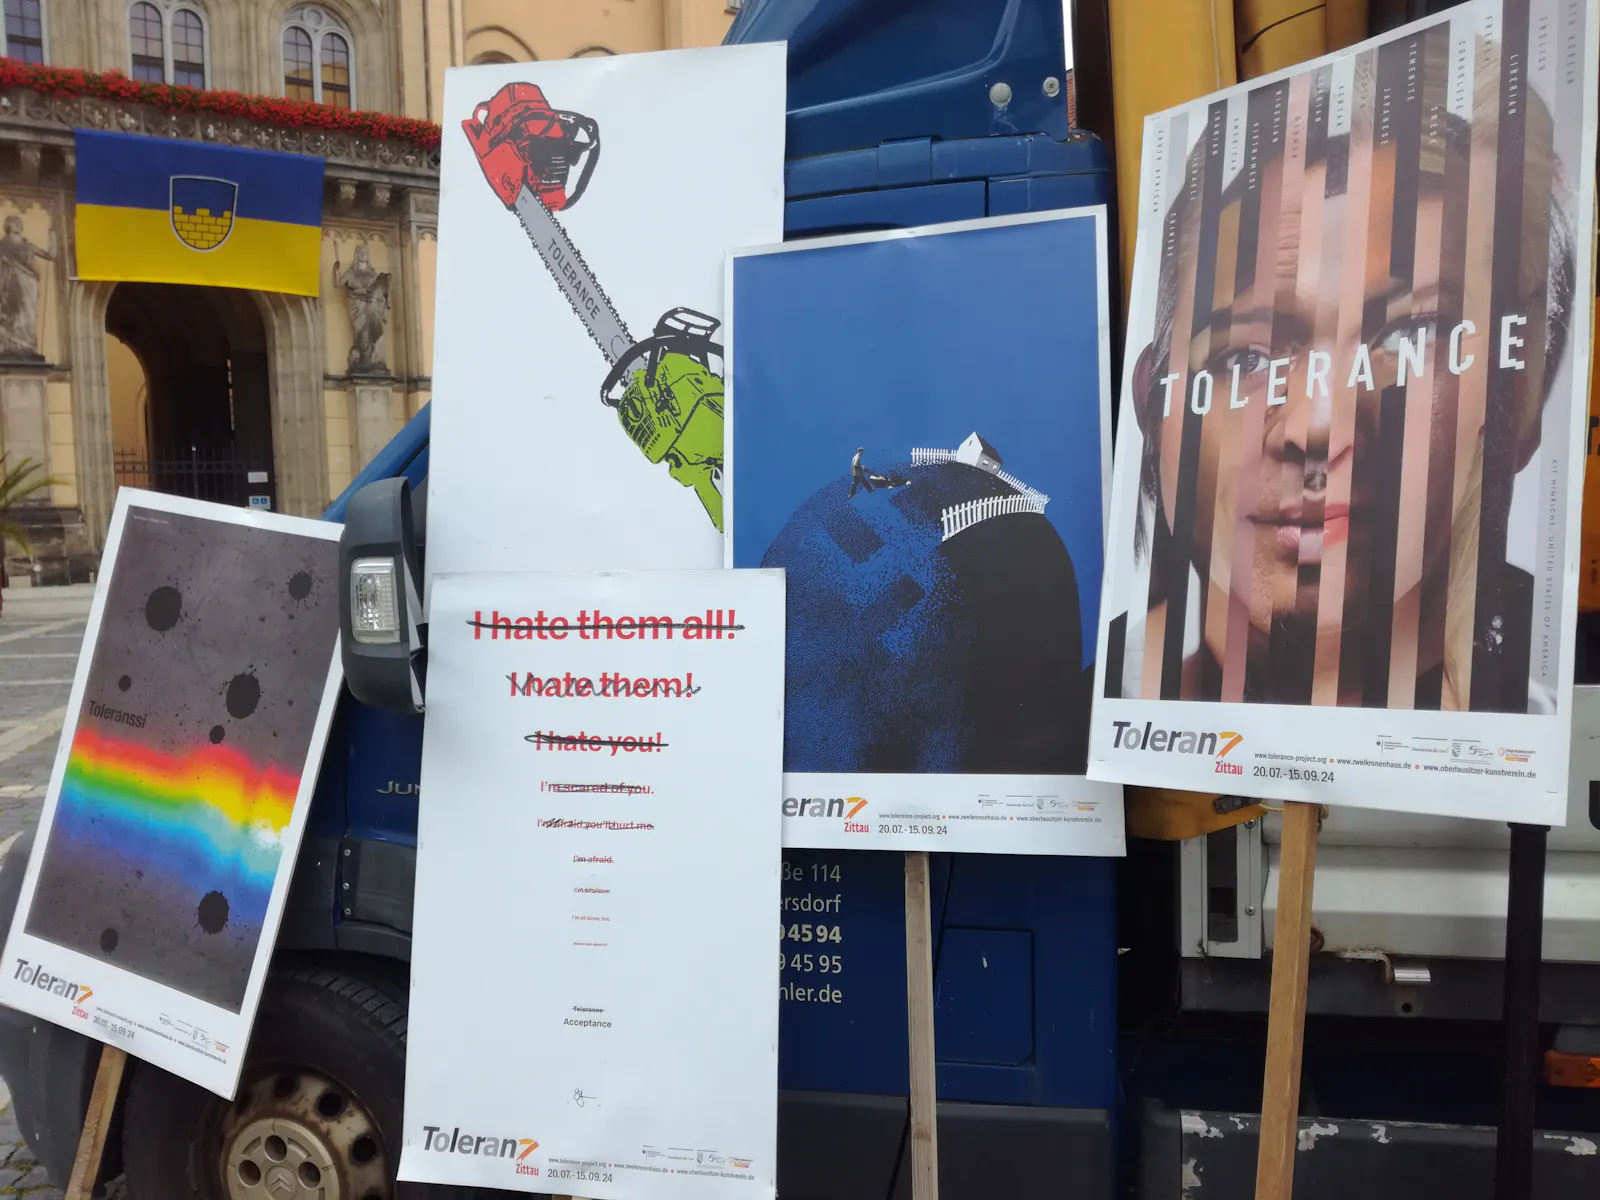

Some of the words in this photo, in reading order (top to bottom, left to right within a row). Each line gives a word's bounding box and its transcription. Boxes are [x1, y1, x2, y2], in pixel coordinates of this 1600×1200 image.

[1407, 43, 1417, 101] YEMENITE
[1456, 41, 1466, 110] CONGOLESE
[1508, 54, 1518, 115] LIBERIAN
[1272, 90, 1282, 143] NIGERIAN
[1336, 85, 1344, 127] KENYAN
[1381, 88, 1391, 145] JAPANESE
[1212, 110, 1221, 155] IRANIAN
[1429, 106, 1438, 144] SWEDE
[1156, 130, 1164, 161] SOUTH
[1230, 117, 1240, 171] AMERICAN
[1248, 122, 1259, 190] VIETNAMESE
[1153, 169, 1161, 213] AFRICAN
[1167, 212, 1176, 257] CHINESE
[547, 238, 600, 320] TOLERANCE
[1160, 314, 1527, 418] TOLERANCE
[474, 610, 481, 639] I
[491, 610, 570, 640] hate
[577, 609, 673, 640] them
[682, 609, 736, 640] all!
[1543, 616, 1550, 628] OF
[1541, 635, 1549, 678] AMERICA
[511, 672, 517, 697] I
[526, 672, 592, 698] hate
[600, 672, 693, 698] them!
[88, 700, 147, 729] Toleranssi
[548, 731, 602, 751] hate
[610, 732, 662, 756] you!
[1215, 761, 1243, 776] Zittau
[1254, 752, 1327, 764] www.tolerance-project.org
[1337, 757, 1412, 770] www.zweikronenhaus.de
[1423, 764, 1537, 779] www.oberlausitzer-kunstverein.de
[563, 782, 608, 793] scared
[611, 782, 626, 793] of
[626, 785, 655, 796] you.
[844, 822, 869, 833] Zittau
[811, 863, 841, 882] 114
[780, 893, 841, 913] rsdorf
[790, 954, 814, 972] 45
[819, 955, 842, 973] 95
[72, 1005, 89, 1020] Zittau
[563, 1018, 612, 1028] Acceptance
[515, 1163, 539, 1176] Zittau
